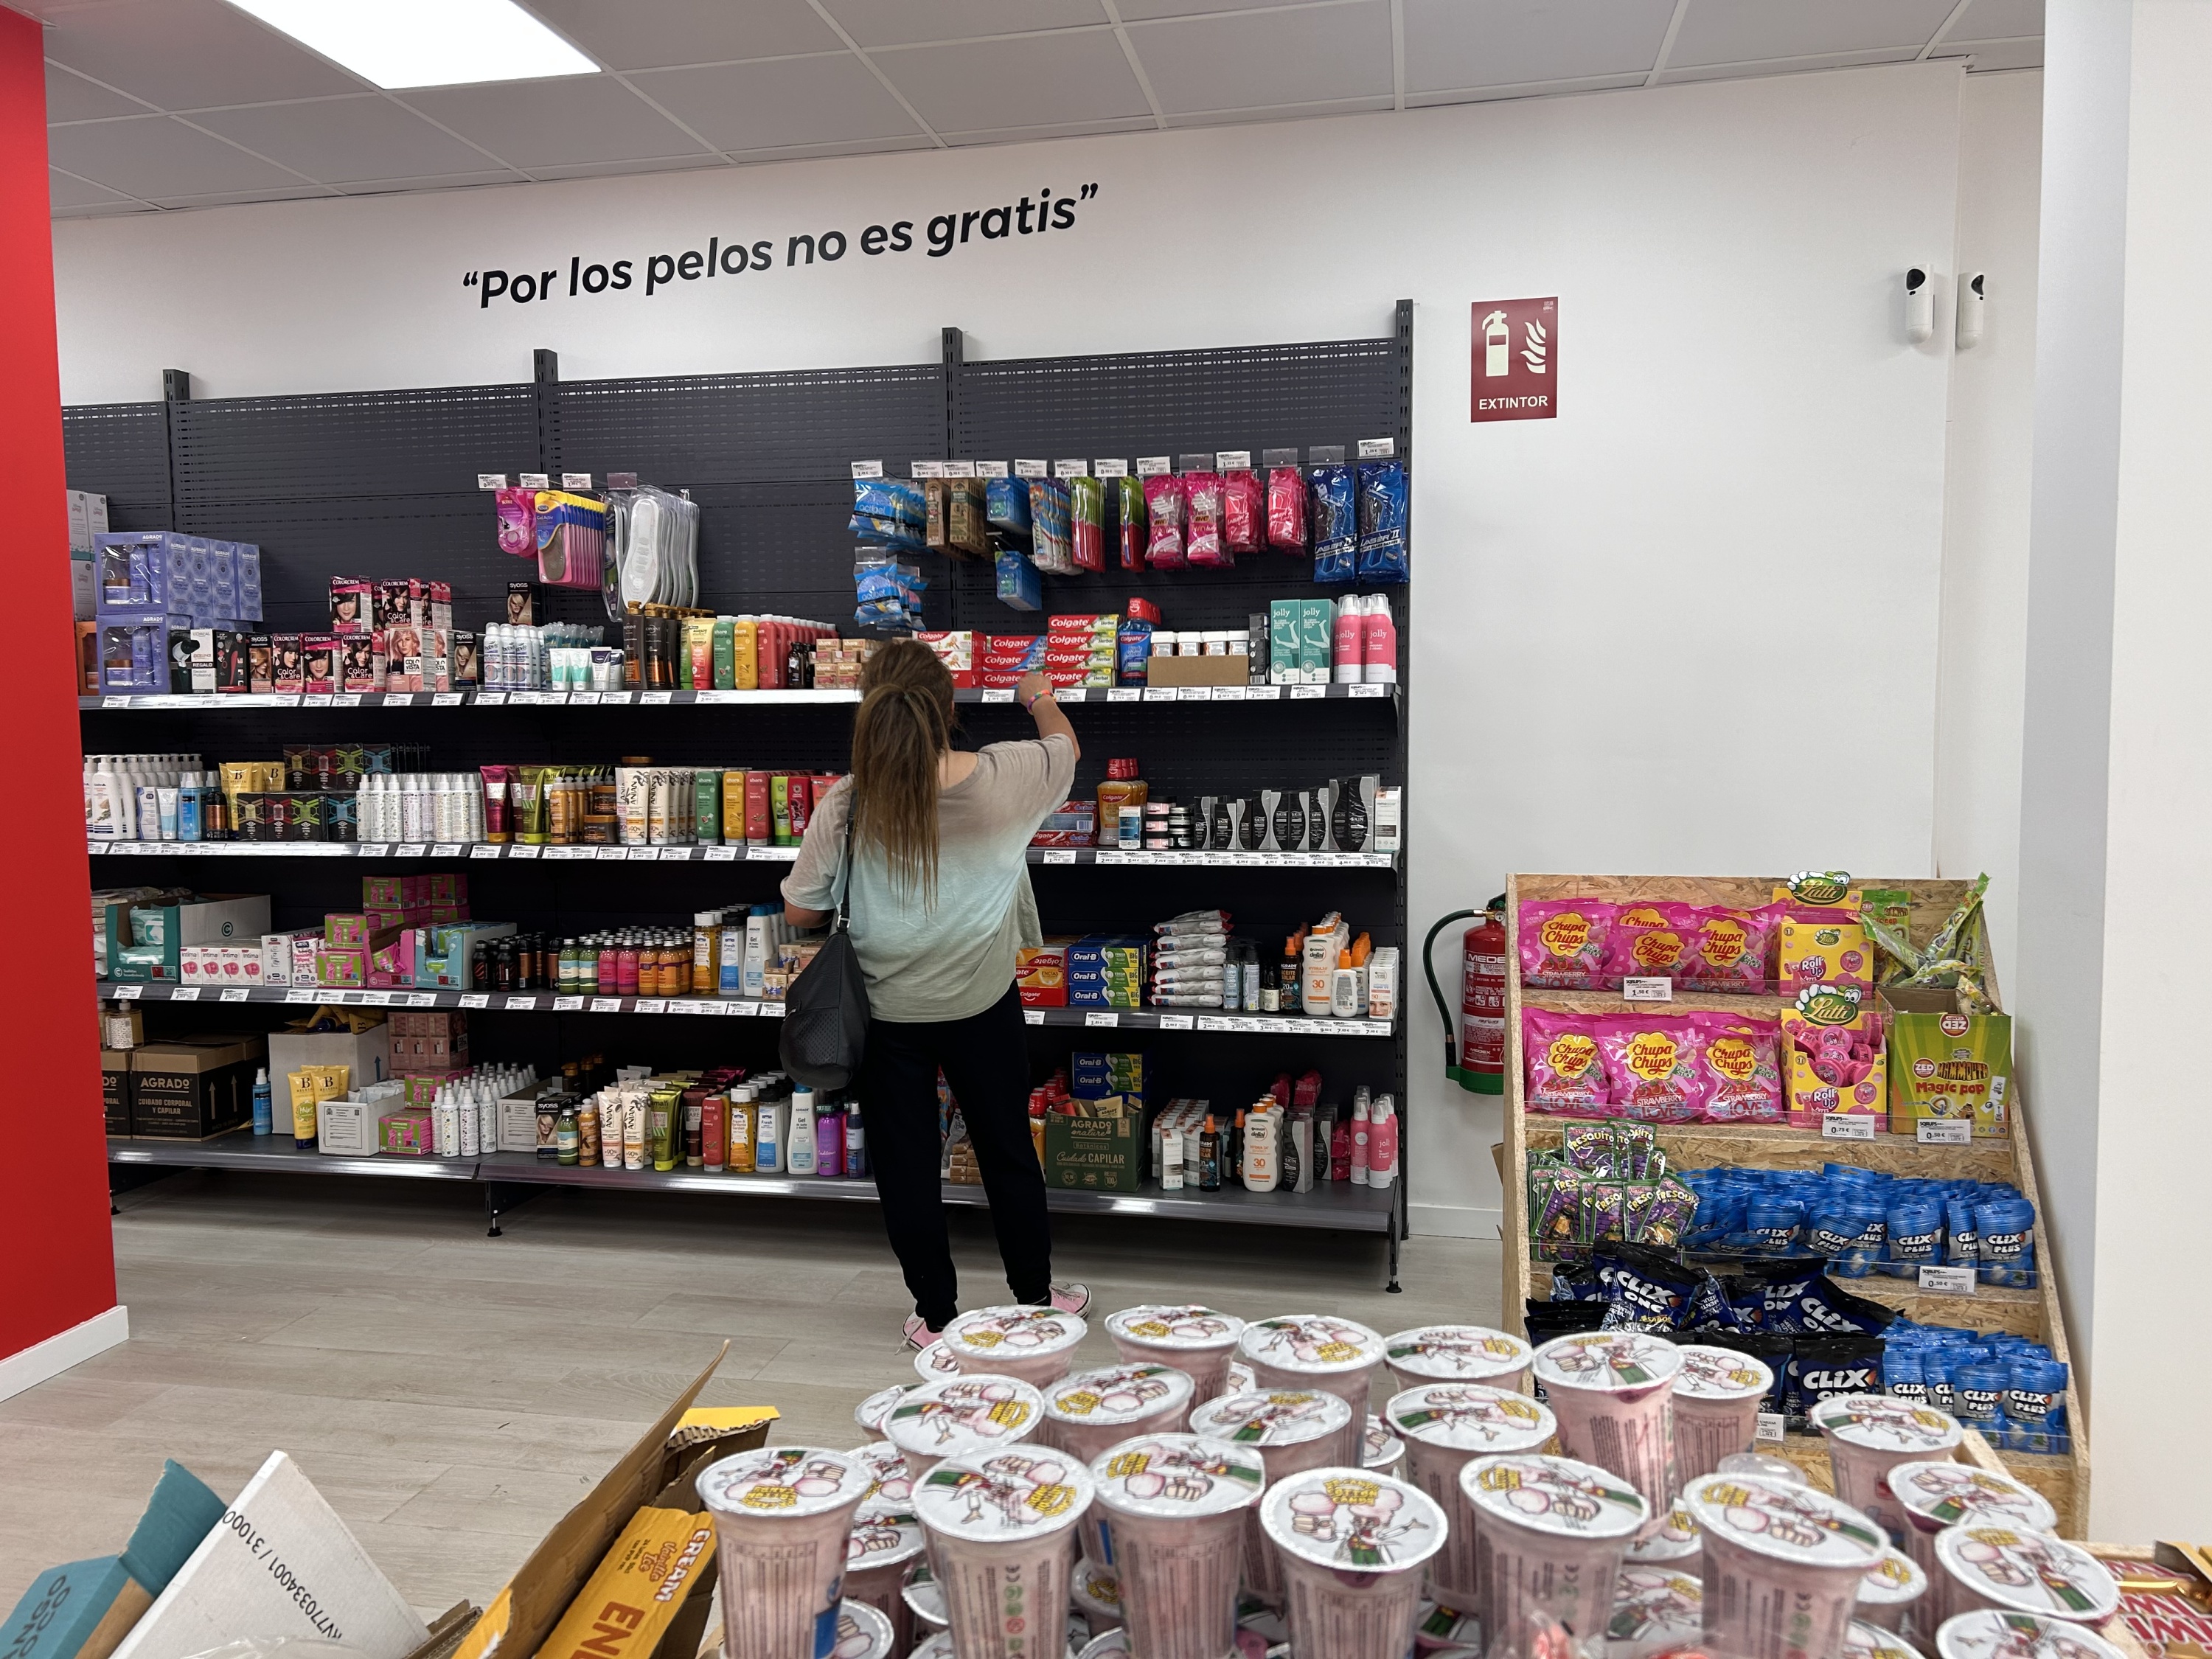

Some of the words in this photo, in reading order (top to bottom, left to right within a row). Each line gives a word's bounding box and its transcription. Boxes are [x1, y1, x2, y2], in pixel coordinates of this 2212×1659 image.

[462, 268, 557, 309] “Por
[569, 256, 633, 296] los
[646, 237, 773, 295] pelos
[787, 229, 846, 267] no
[860, 219, 914, 255] es
[927, 182, 1099, 258] gratis”
[1479, 395, 1548, 410] EXTINTOR
[1360, 535, 1388, 547] LASER
[1273, 608, 1290, 619] jolly
[1303, 607, 1321, 618] jolly
[1050, 618, 1089, 629] Colgate
[919, 632, 944, 641] Colgate
[1339, 630, 1355, 640] jolly
[1370, 629, 1388, 639] jolly
[993, 639, 1030, 648] Colgate
[1049, 636, 1088, 646] Colgate
[984, 655, 1022, 665] Colgate
[1046, 653, 1086, 664] Colgate
[984, 674, 1021, 684] Colgate
[1045, 672, 1082, 683] Colgate
[1795, 879, 1841, 900] Lutti
[1548, 921, 1586, 934] Chupa
[1545, 931, 1585, 947] Chups
[1641, 936, 1680, 953] Chupa
[1636, 945, 1675, 964] Chups
[1702, 942, 1742, 957] Chups
[1074, 953, 1097, 961] Oral-B
[1467, 953, 1506, 964] MEDE
[1073, 972, 1097, 981] Oral-B
[1811, 966, 1823, 976] UP
[1312, 979, 1325, 989] 30
[1074, 991, 1099, 1000] Oral-B
[1806, 997, 1849, 1022] Lutti
[1942, 1020, 1966, 1030] ZED
[1557, 1043, 1595, 1057] Chupa
[1633, 1044, 1673, 1057] Chupa
[1712, 1047, 1750, 1060] Chupa
[1552, 1054, 1588, 1069] Chups
[1632, 1056, 1673, 1071] Chups
[1714, 1057, 1753, 1073] Chups
[1676, 1065, 1696, 1077] PAPER
[1676, 1071, 1695, 1079] STICK
[1758, 1071, 1778, 1080] STICK
[1936, 1061, 1989, 1081] MAMMOUTH
[301, 1077, 310, 1088] B
[324, 1076, 333, 1088] B
[1916, 1081, 1956, 1094] Magic
[1959, 1082, 1985, 1095] pop
[164, 1099, 192, 1107] CORPORAL
[1636, 1094, 1683, 1107] STRAWBERRY
[1722, 1093, 1768, 1105] STRAWBERRY
[1823, 1099, 1835, 1109] UP
[157, 1107, 181, 1115] CAPILAR
[1641, 1106, 1677, 1119] LOVE
[1727, 1102, 1764, 1116] LOVE
[1057, 1151, 1087, 1163] Cuidado
[1088, 1153, 1124, 1164] CAPILAR
[1253, 1158, 1266, 1167] 30
[1627, 1192, 1654, 1212] FRESQ
[1902, 1245, 1933, 1253] PLUS
[1994, 1245, 2021, 1253] PLUS
[1765, 1281, 1810, 1298] LiX
[1968, 1402, 1994, 1411] PLUS
[2016, 1402, 2047, 1415] PLUS
[223, 1511, 265, 1552] 31000
[639, 1553, 658, 1572] Ice
[654, 1528, 712, 1602] CREAM
[19, 1585, 71, 1659] OCO
